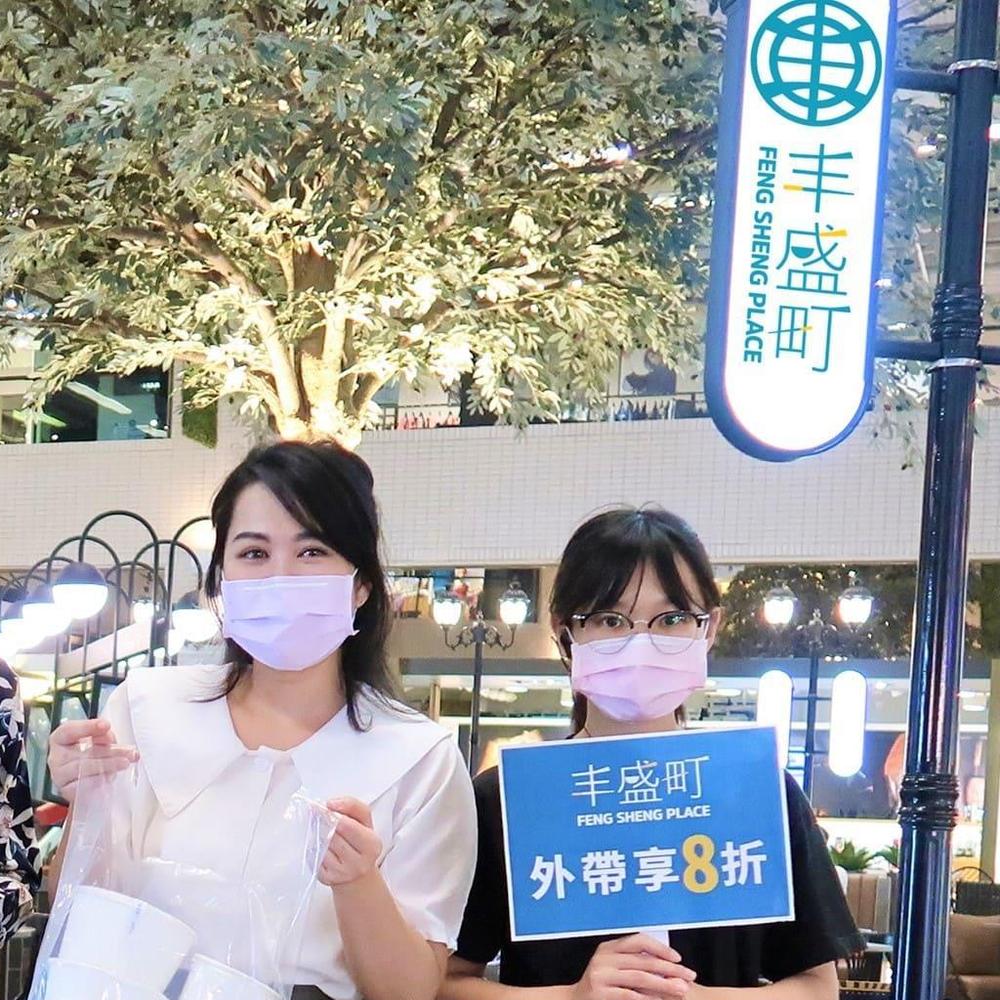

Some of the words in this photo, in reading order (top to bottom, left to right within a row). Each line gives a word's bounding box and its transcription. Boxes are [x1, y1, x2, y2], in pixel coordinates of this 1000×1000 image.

[755, 146, 778, 205] FENG
[749, 210, 774, 286] SHENG
[768, 143, 855, 373] 丰盛町
[743, 292, 767, 364] PLACE
[571, 755, 710, 807] 丰盛町
[576, 812, 614, 827] FENG
[616, 808, 663, 824] SHENG
[666, 804, 711, 820] PLACE
[529, 833, 768, 901] 外帶享8折
